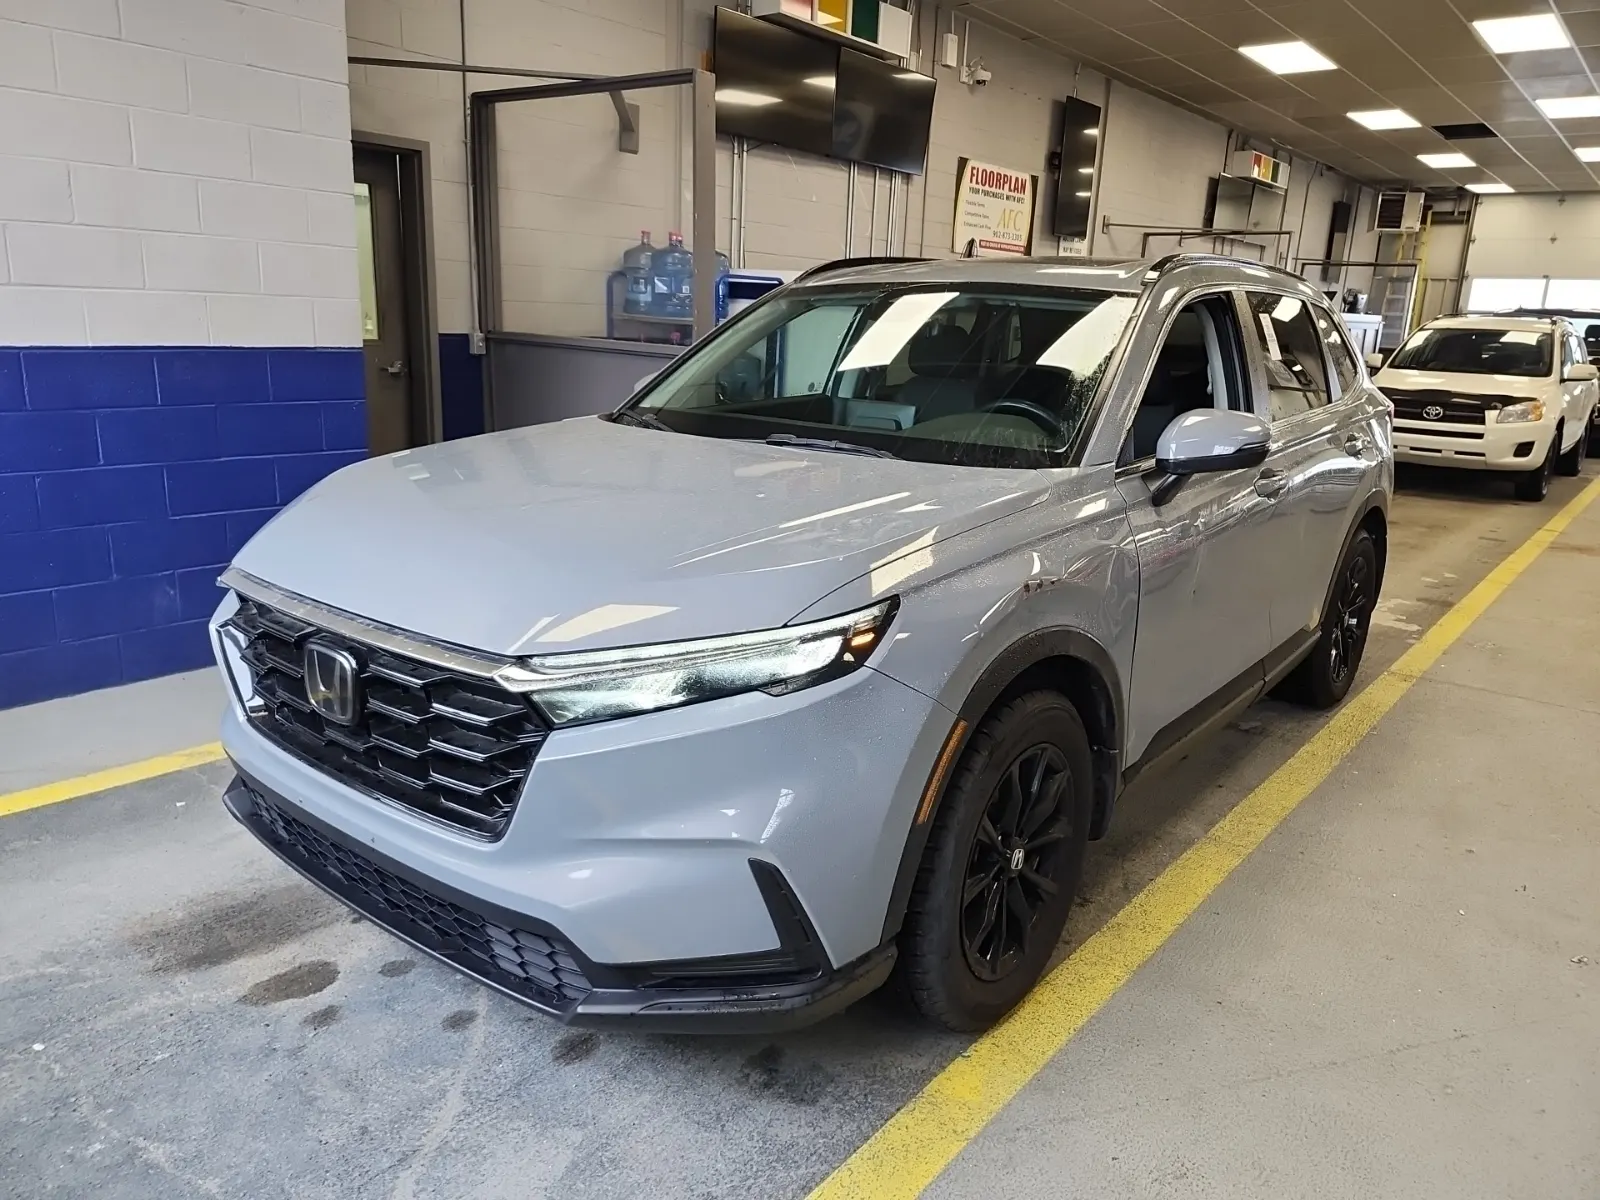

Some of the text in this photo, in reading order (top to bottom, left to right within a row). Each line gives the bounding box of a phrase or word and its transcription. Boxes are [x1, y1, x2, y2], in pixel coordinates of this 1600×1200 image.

[970, 166, 1027, 195] FLOORPLAN
[968, 186, 981, 195] YOUR
[981, 189, 1005, 201] PURCHASES
[1005, 194, 1016, 203] WITH
[997, 208, 1023, 232] AFC
